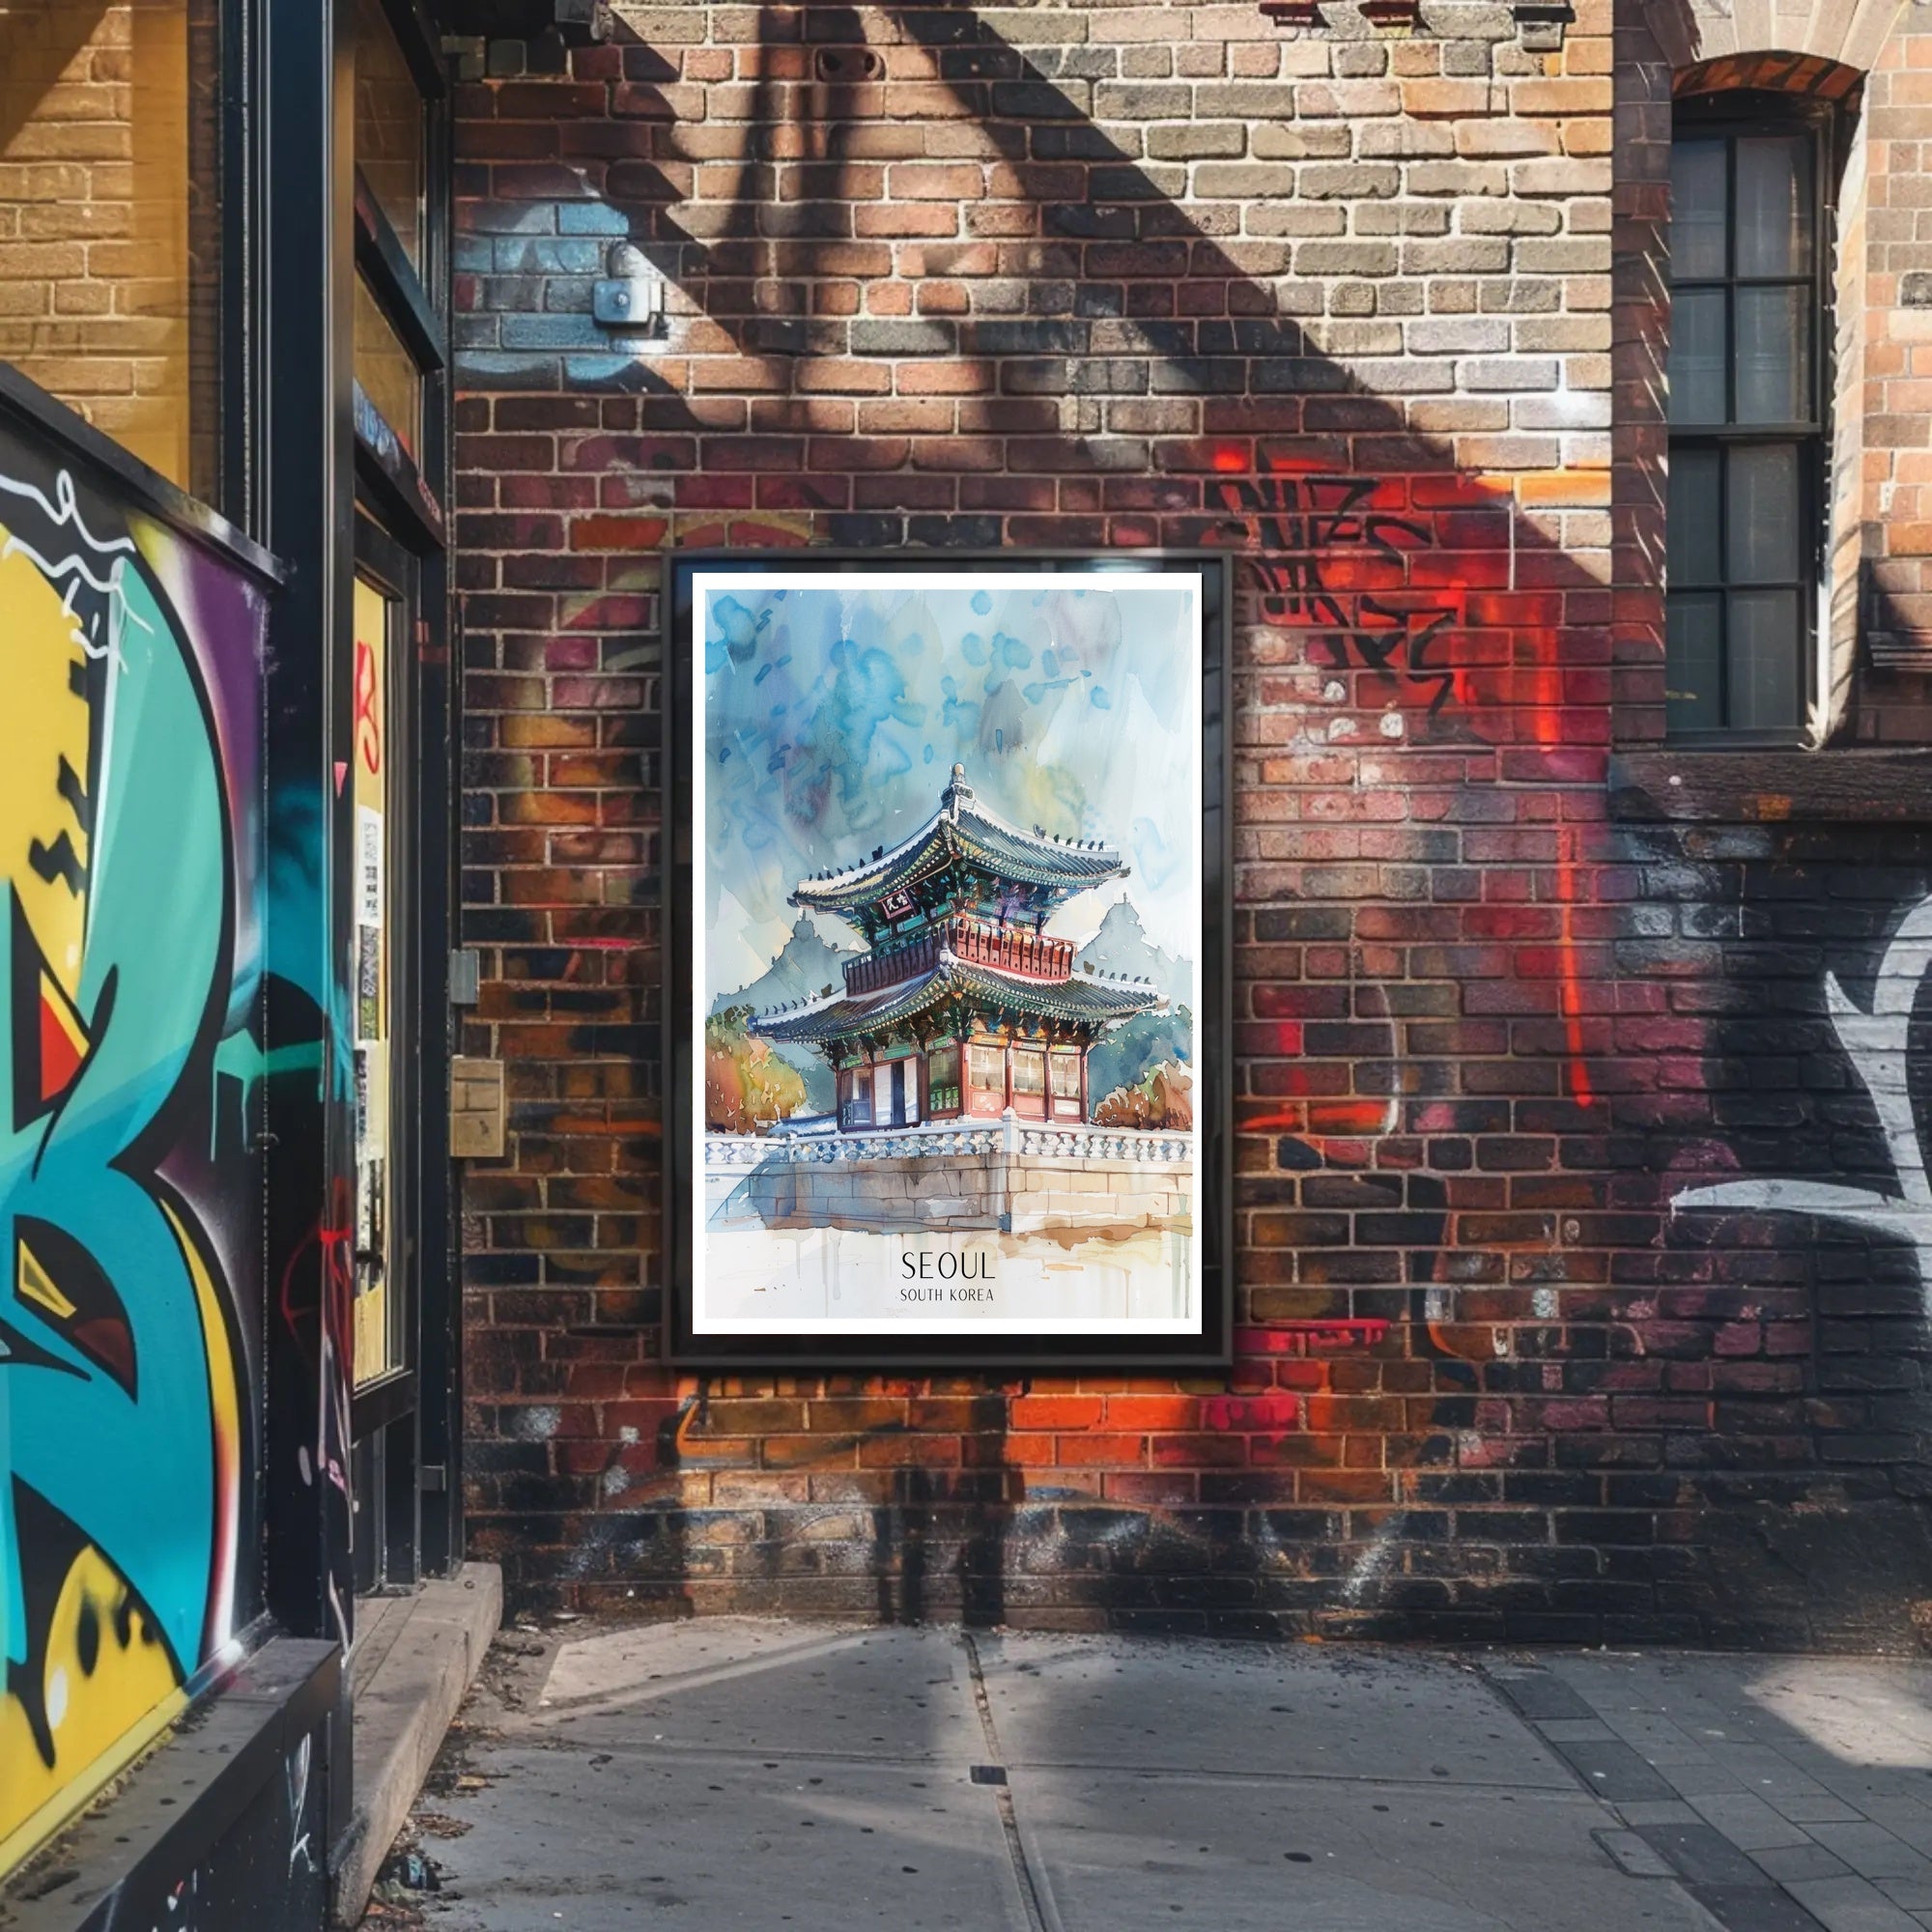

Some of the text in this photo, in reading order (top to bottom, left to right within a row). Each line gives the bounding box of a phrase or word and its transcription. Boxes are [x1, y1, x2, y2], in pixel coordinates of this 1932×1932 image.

[901, 1252, 996, 1279] SEOUL
[900, 1288, 994, 1301] SOUTH KOREA
